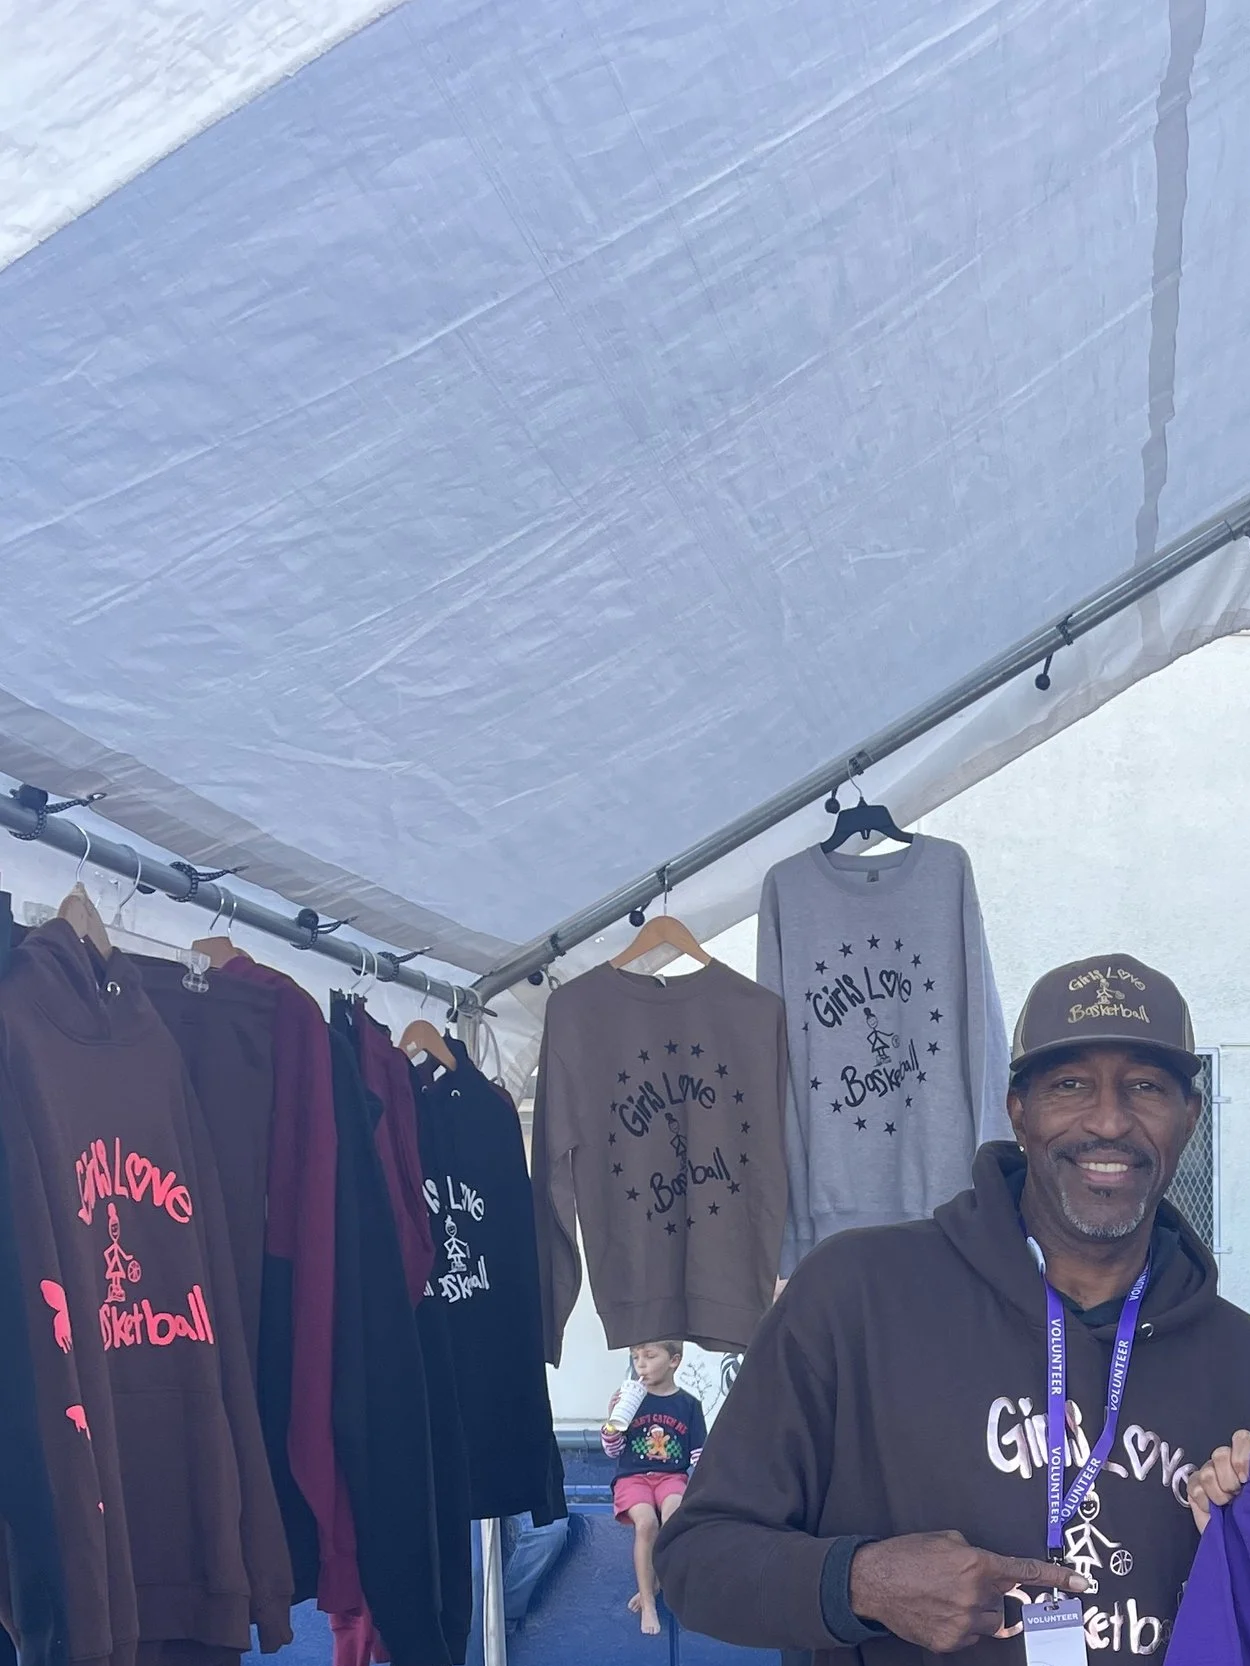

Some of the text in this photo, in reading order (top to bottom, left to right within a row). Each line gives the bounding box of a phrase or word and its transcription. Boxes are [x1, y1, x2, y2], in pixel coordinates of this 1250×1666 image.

[813, 974, 866, 1028] Girls
[1068, 966, 1146, 991] Girls Love
[1068, 1003, 1150, 1023] Basketball
[619, 1072, 716, 1137] Girls Love
[114, 1137, 193, 1223] Love
[99, 1284, 214, 1351] sketball
[1051, 1318, 1062, 1395] VOLUNTEER
[1111, 1340, 1129, 1411] VOLUNTEER
[1050, 1447, 1062, 1524] VOLUNTEER
[1062, 1457, 1101, 1521] OLUNTEER
[1102, 1424, 1200, 1508] ove
[1028, 1613, 1079, 1625] VOLUNTEER
